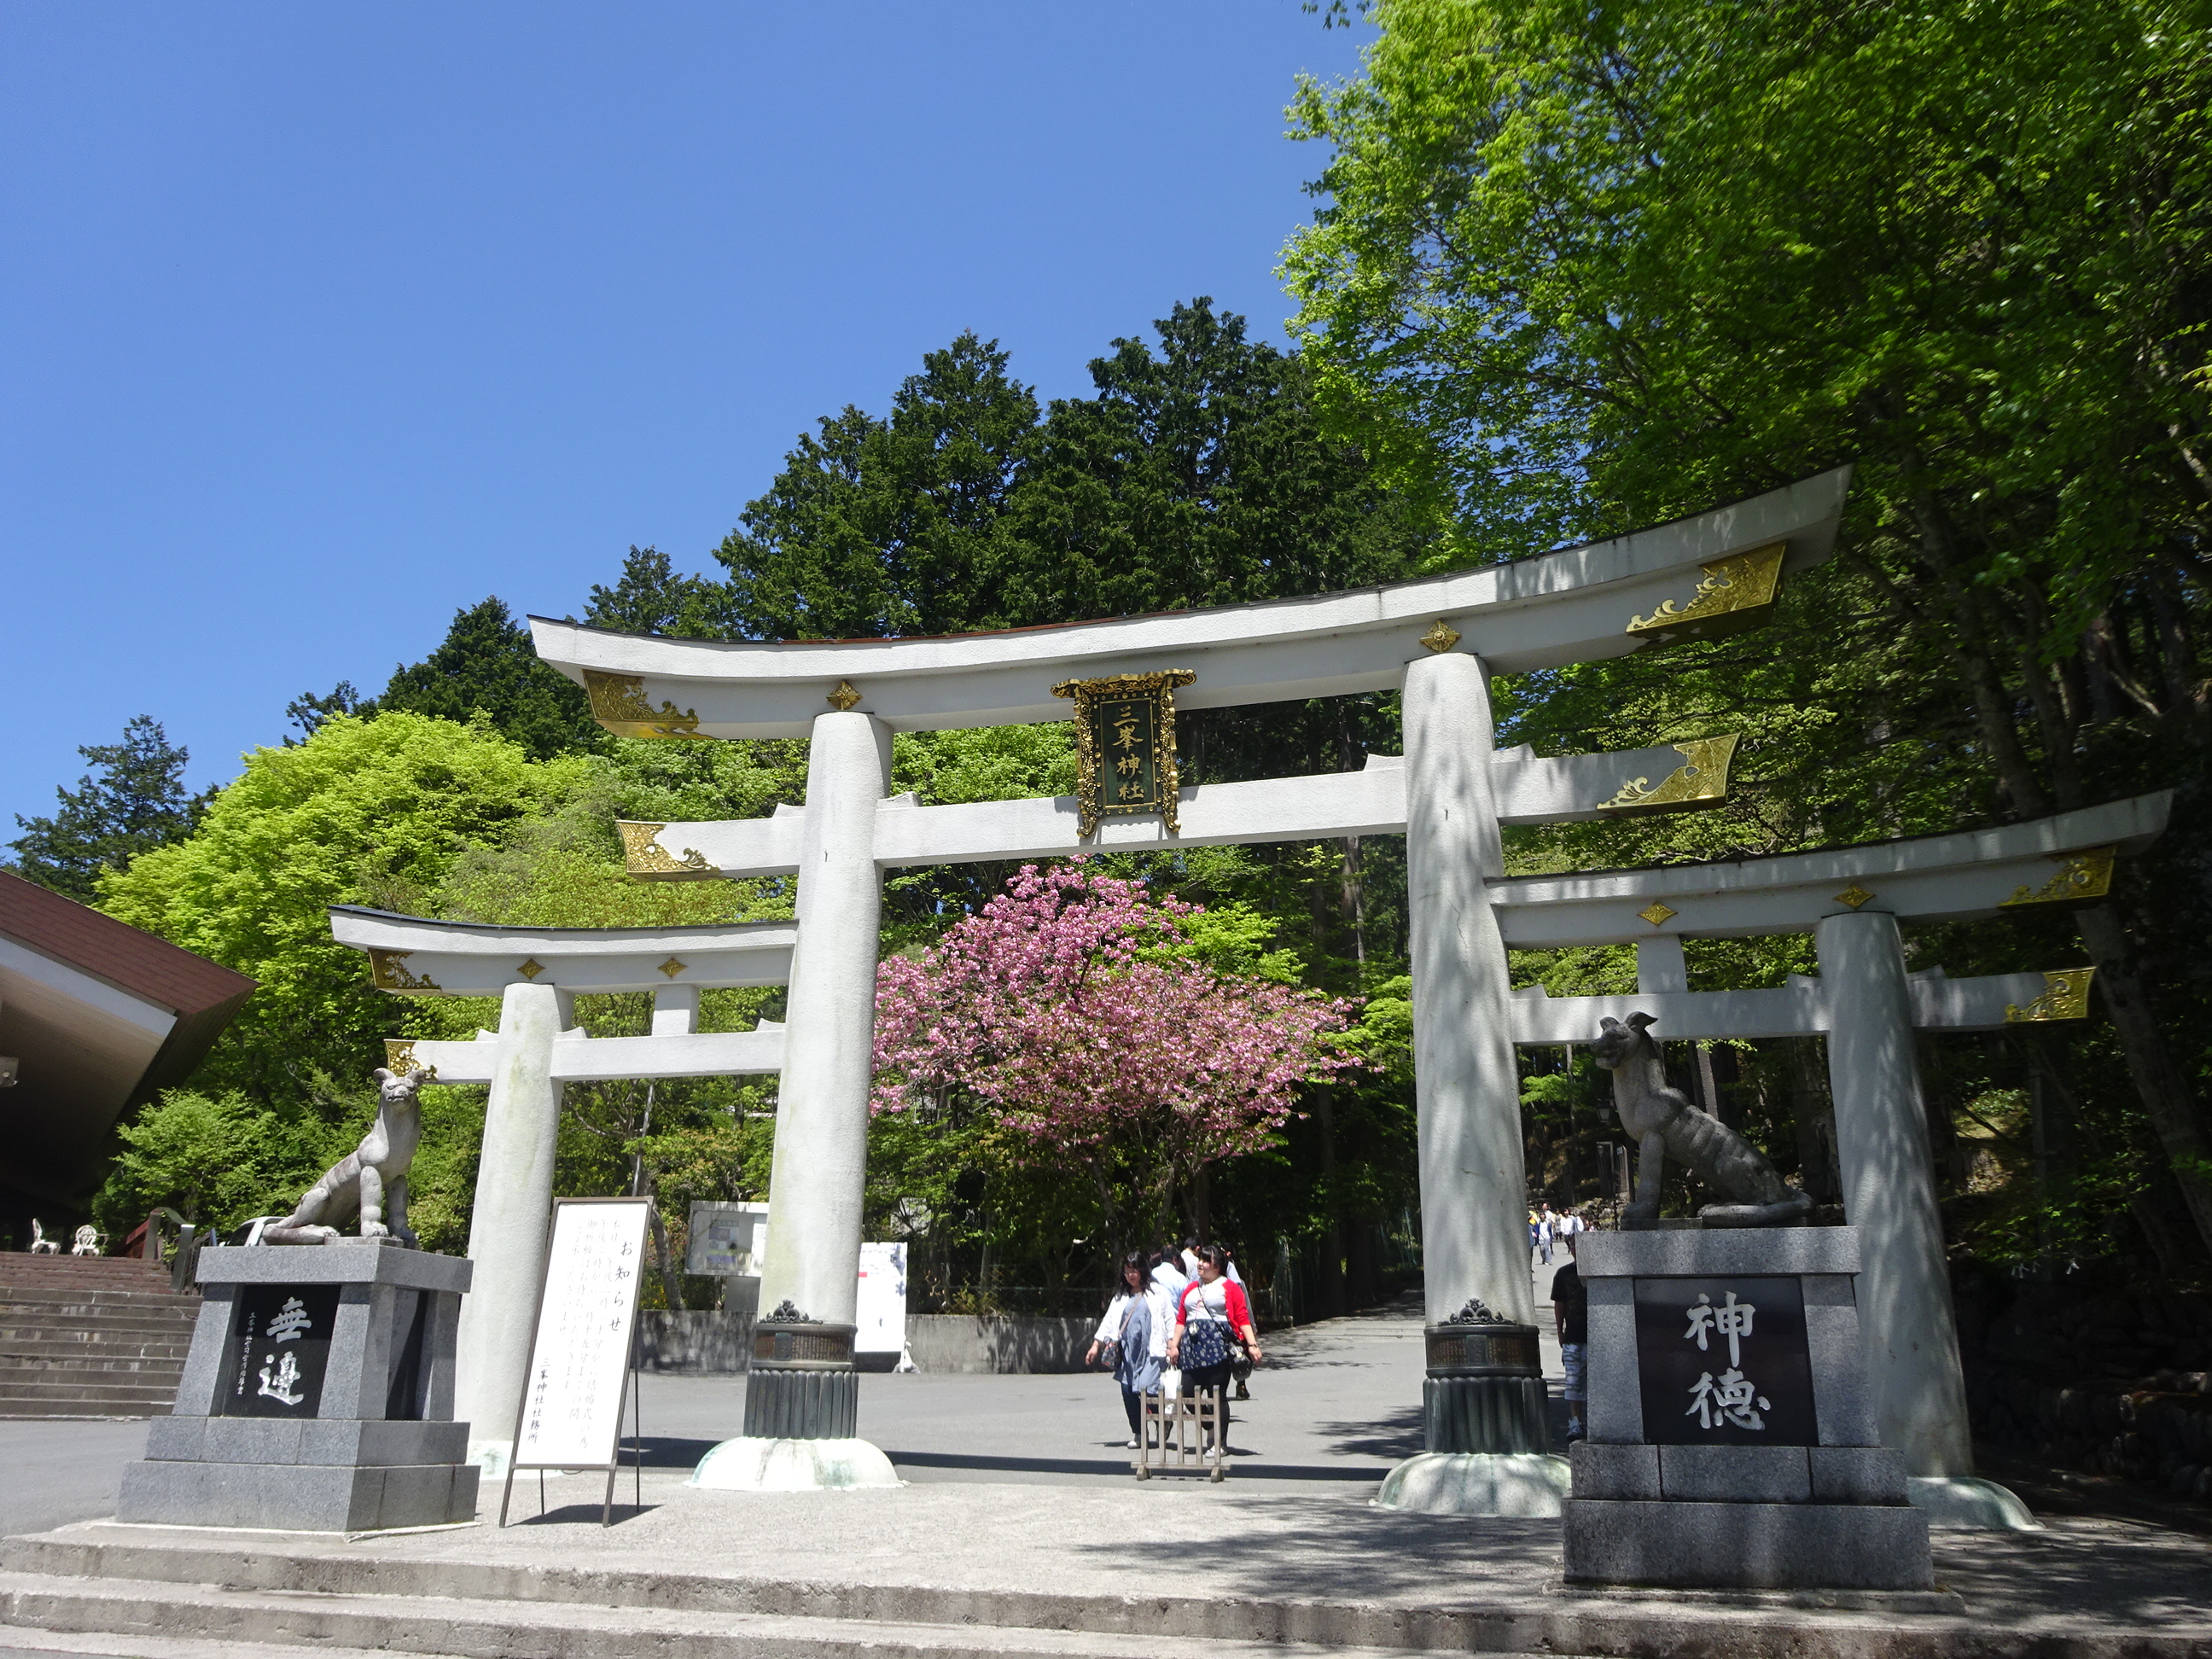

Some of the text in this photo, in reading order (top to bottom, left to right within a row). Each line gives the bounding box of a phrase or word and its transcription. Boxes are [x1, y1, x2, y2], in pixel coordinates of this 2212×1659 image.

[1112, 705, 1144, 801] 三峯神社
[608, 1241, 633, 1332] お知らせ
